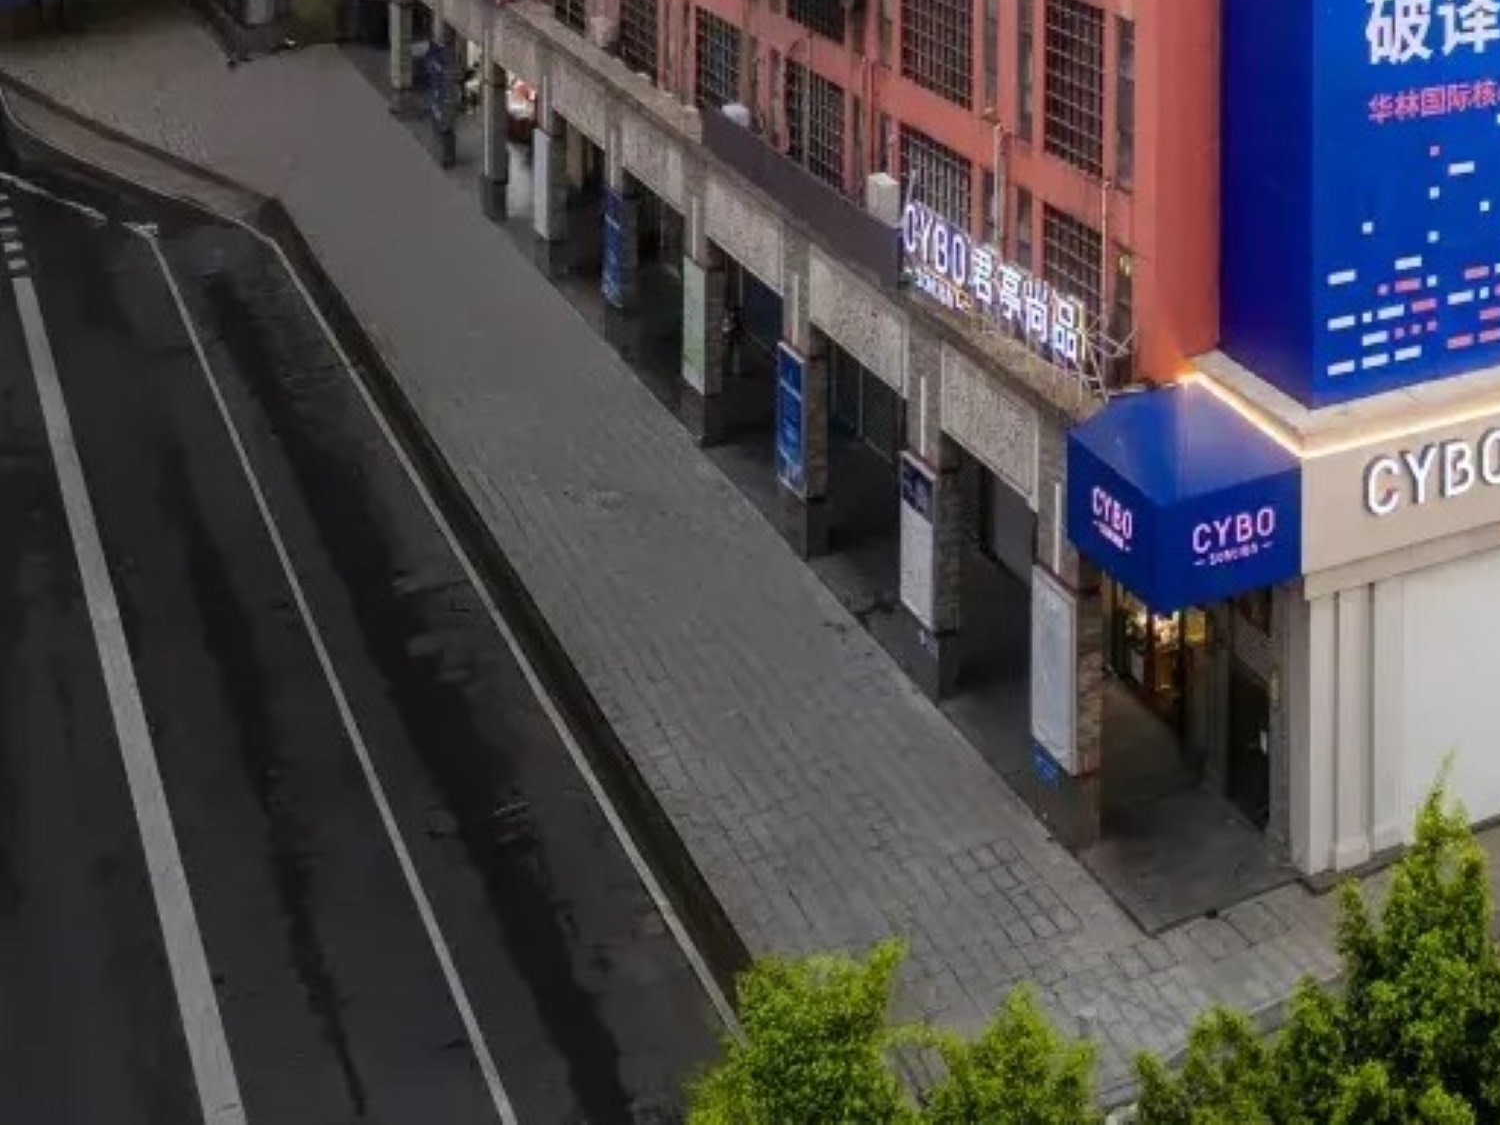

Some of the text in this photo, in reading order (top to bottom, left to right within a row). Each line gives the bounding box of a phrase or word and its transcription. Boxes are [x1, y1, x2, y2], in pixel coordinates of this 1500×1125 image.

[903, 203, 966, 286] CYBO
[970, 244, 1080, 364] 君亭尚品
[1092, 486, 1133, 540] CYBO
[1192, 506, 1276, 554] CYBO
